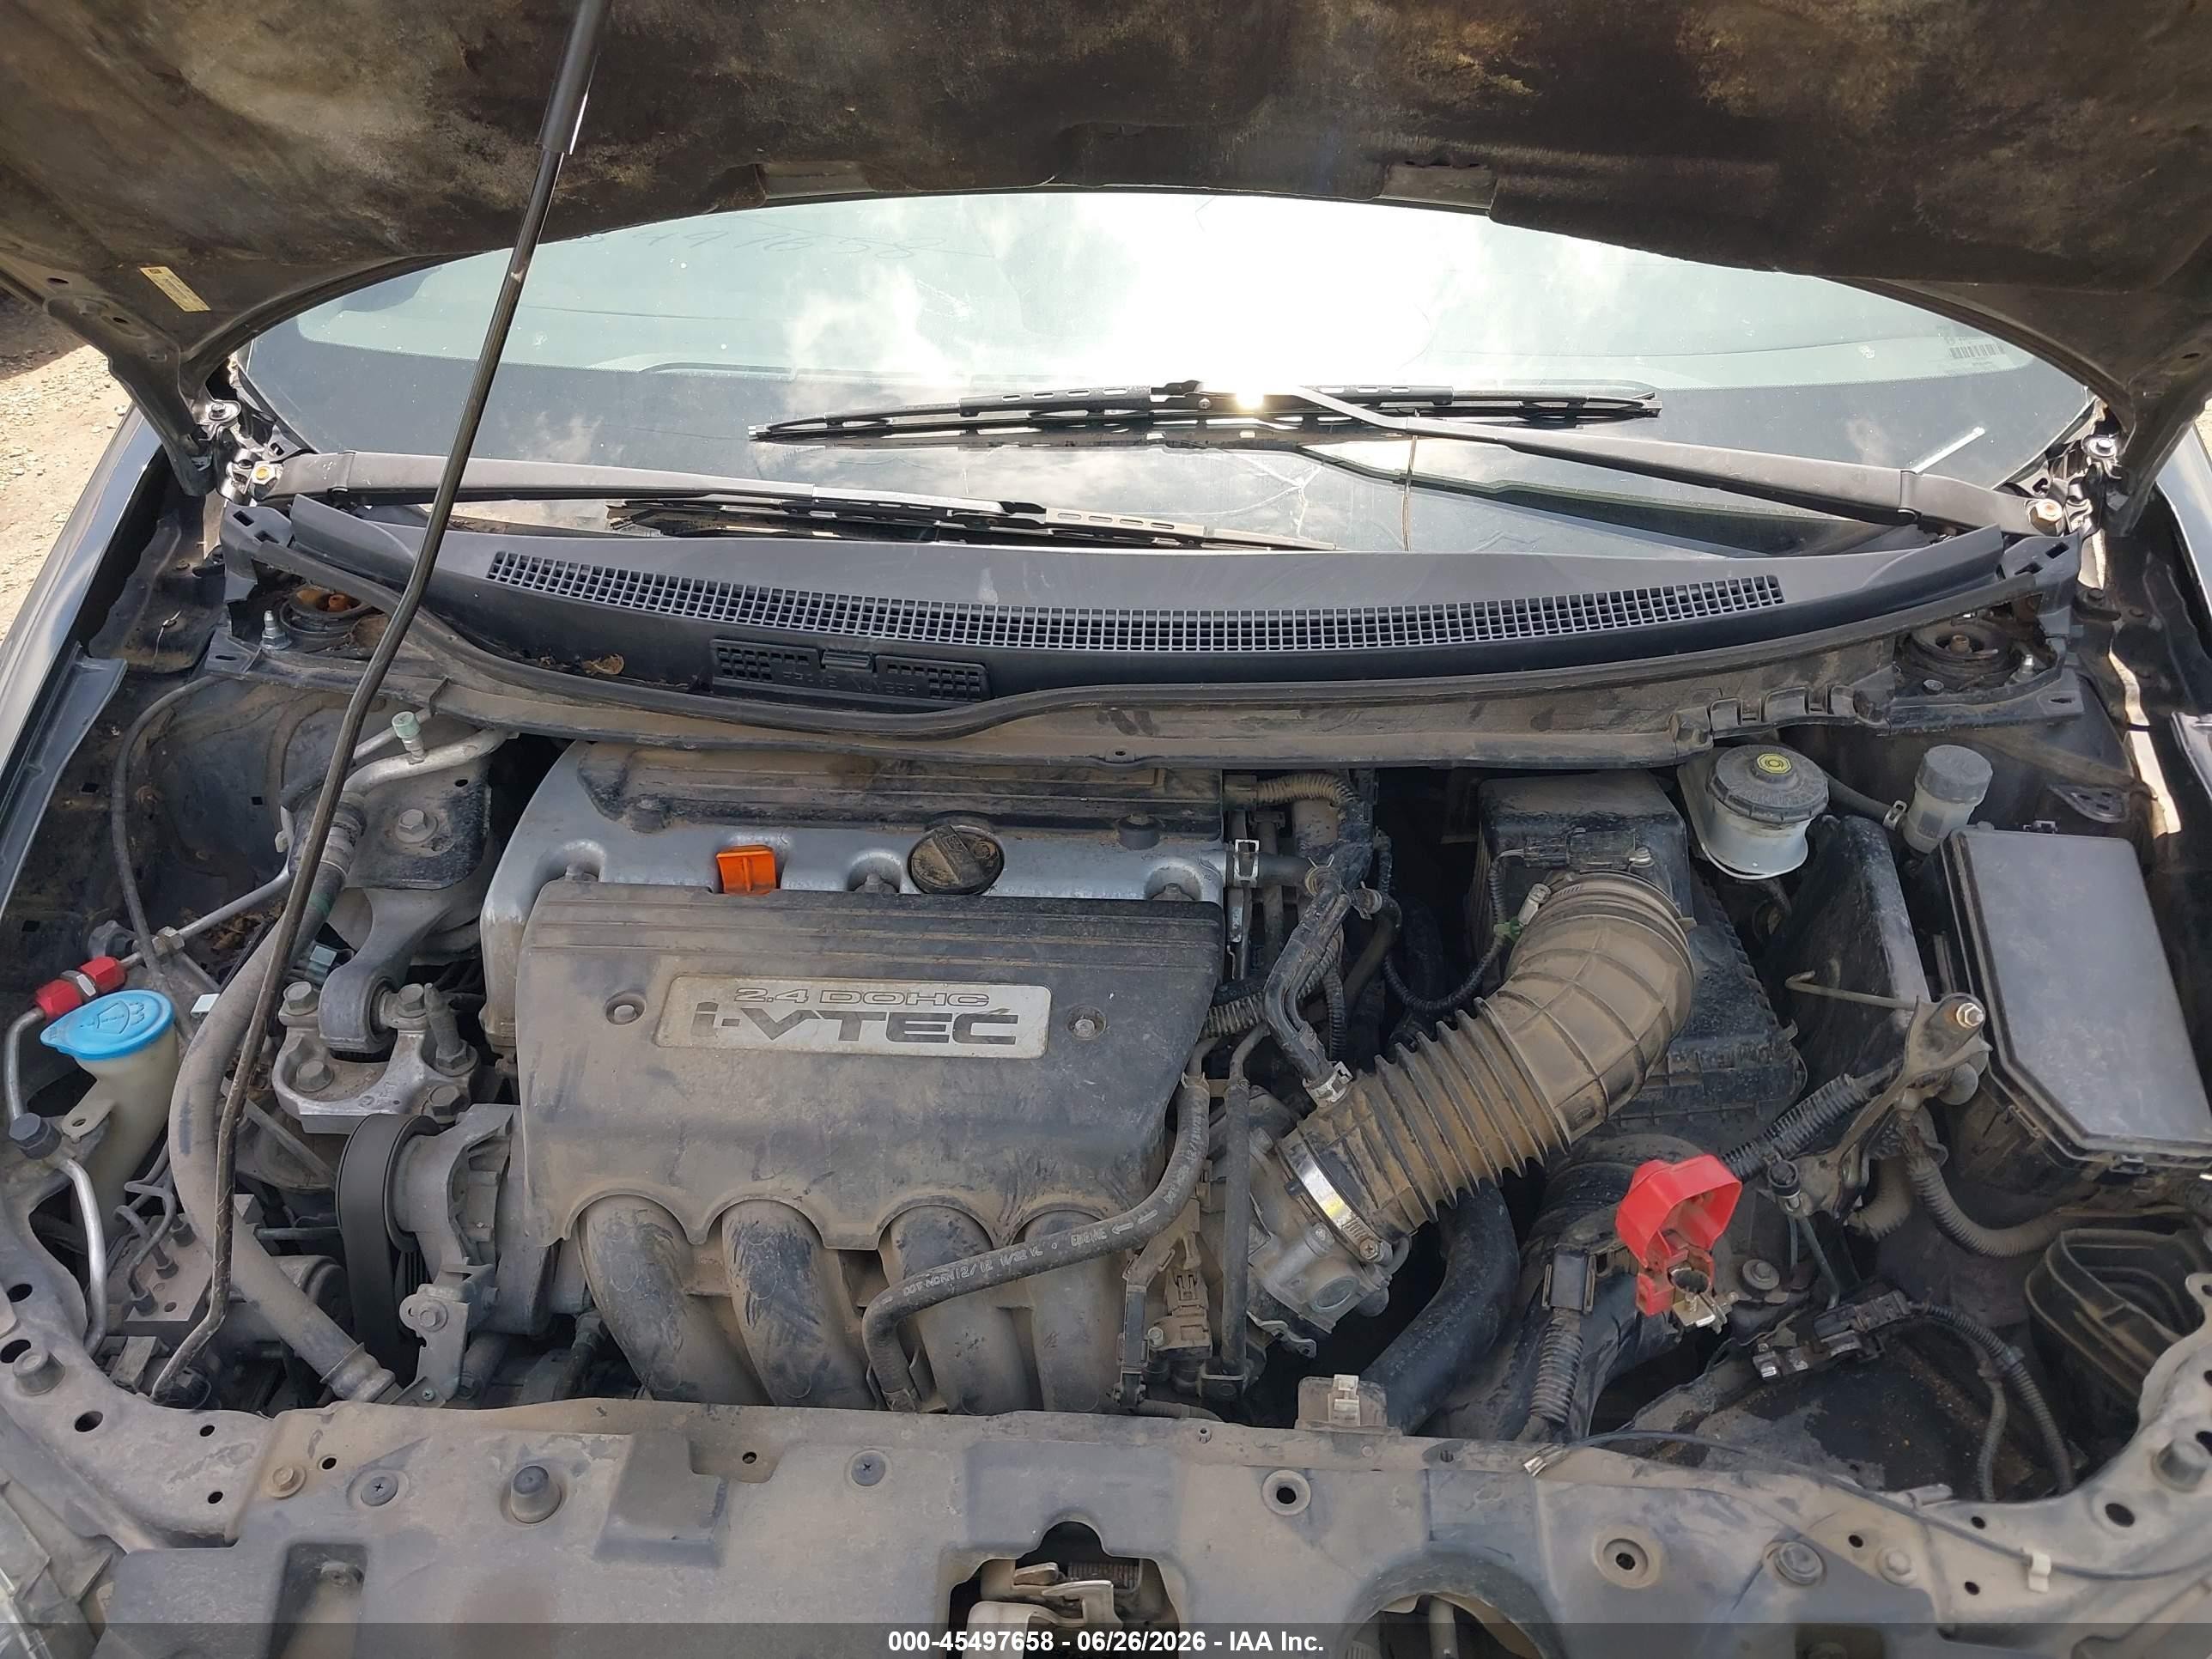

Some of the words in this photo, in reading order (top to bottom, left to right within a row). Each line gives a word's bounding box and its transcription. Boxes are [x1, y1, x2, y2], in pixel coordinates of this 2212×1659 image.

[734, 987, 809, 1004] 2.4
[818, 989, 990, 1006] DOHC
[694, 1000, 1019, 1047] i-VTEC
